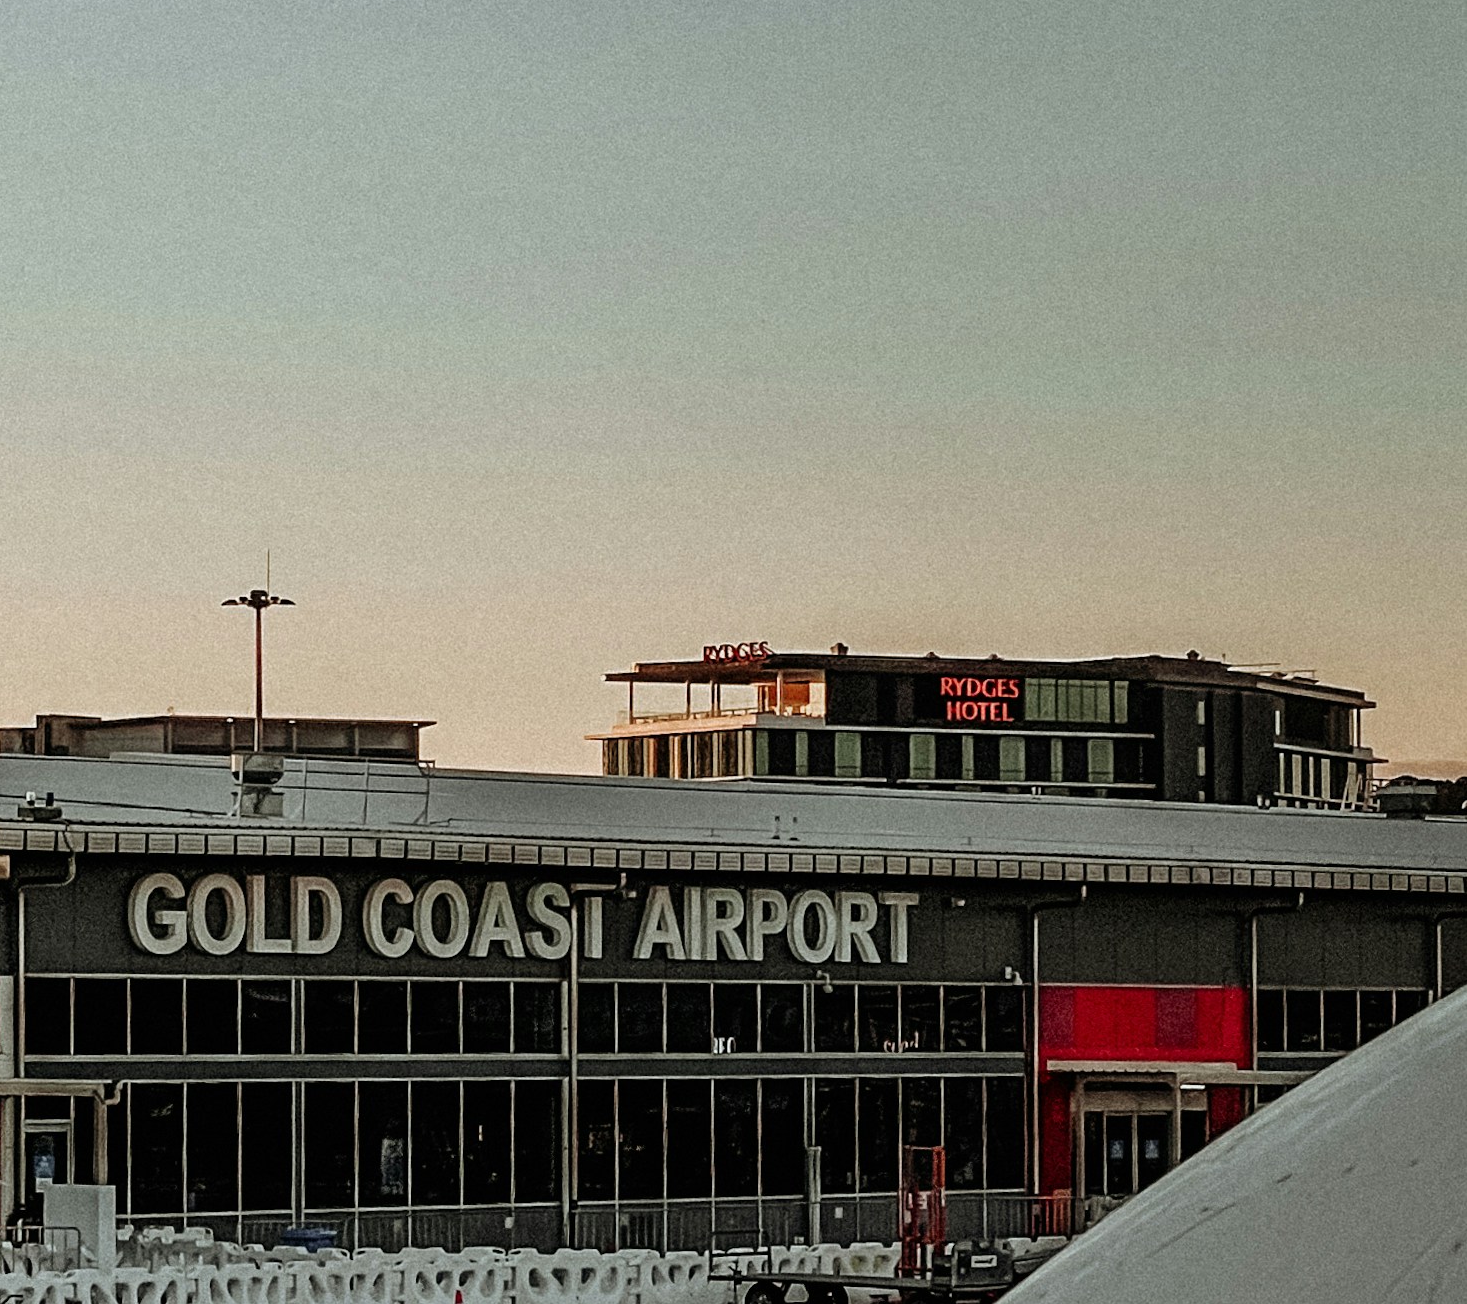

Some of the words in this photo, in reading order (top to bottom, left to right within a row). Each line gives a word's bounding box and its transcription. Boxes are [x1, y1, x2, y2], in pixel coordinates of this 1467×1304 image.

[703, 641, 770, 663] RYDGES
[940, 677, 1019, 698] RYDGES
[946, 701, 1015, 722] HOTEL
[128, 872, 342, 956] GOLD
[363, 878, 616, 960] COAST
[633, 885, 919, 963] AIRPORT
